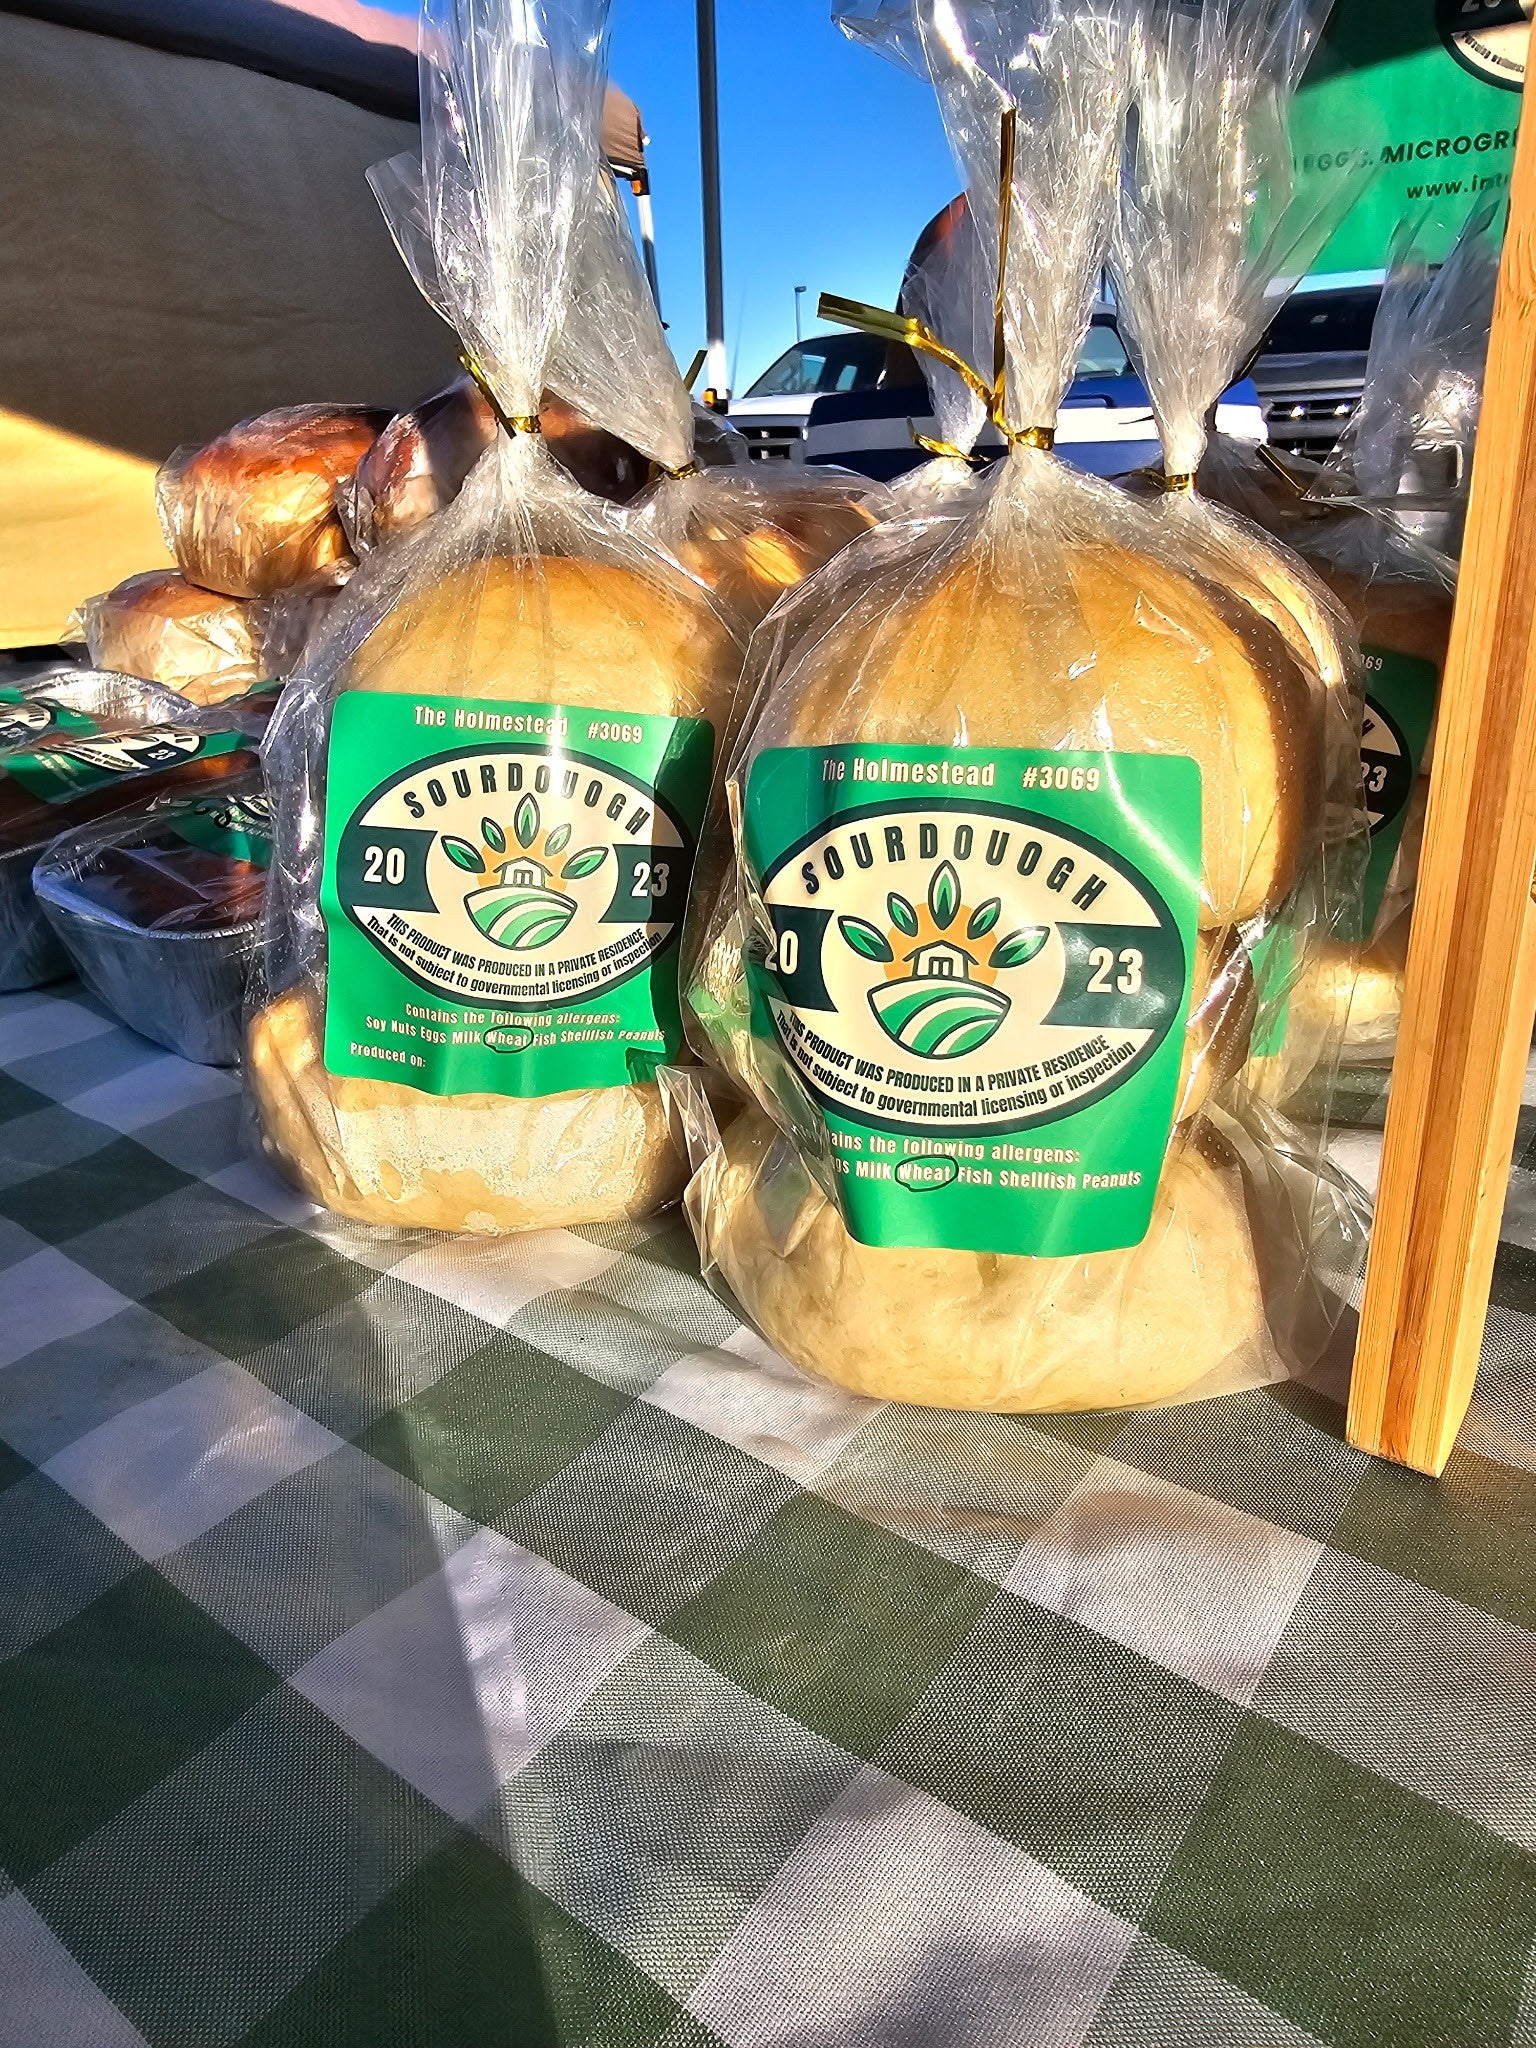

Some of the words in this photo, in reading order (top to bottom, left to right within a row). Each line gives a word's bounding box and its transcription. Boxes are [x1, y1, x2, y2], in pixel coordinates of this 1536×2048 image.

[415, 706, 446, 727] The
[454, 708, 568, 736] Holmestead
[587, 722, 643, 744] #3069
[821, 758, 846, 782] The
[853, 757, 996, 787] Holmestead
[1022, 765, 1101, 791] #3069
[403, 762, 651, 836] SOURDOUOGH
[363, 845, 406, 885] 20
[631, 865, 668, 898] 23
[801, 823, 1108, 912] SOURDOUOGH
[367, 916, 389, 935] That
[388, 932, 398, 947] is
[399, 943, 416, 962] not
[415, 955, 456, 984] subject
[456, 972, 469, 988] to
[470, 978, 549, 996] governmental
[552, 970, 600, 993] licensing
[601, 962, 612, 977] or
[613, 931, 662, 971] inspection
[386, 913, 409, 936] THIS
[409, 927, 452, 961] PRODUCT
[451, 950, 477, 970] WAS
[477, 959, 531, 977] PRODUCED
[534, 963, 545, 977] IN
[548, 962, 556, 976] A
[557, 954, 598, 975] PRIVATE
[599, 928, 645, 962] RESIDENCE
[1086, 947, 1143, 995] 23
[366, 1015, 387, 1032] Soy
[391, 1020, 417, 1037] Nuts
[420, 1026, 447, 1044] Eggs
[452, 1030, 481, 1045] Milk
[485, 1031, 528, 1047] Wheat
[532, 1033, 557, 1047] Fish
[560, 1029, 614, 1043] Shellfish
[618, 1028, 666, 1041] Peanuts
[405, 1003, 458, 1024] Contains
[463, 1011, 485, 1024] the
[490, 1012, 552, 1027] following
[556, 1012, 620, 1025] allergens:
[349, 1042, 406, 1064] Produced
[410, 1054, 426, 1068] on:
[776, 1009, 792, 1041] That
[790, 1031, 798, 1051] is
[796, 1045, 814, 1070] not
[812, 1062, 859, 1099] subject
[860, 1086, 875, 1105] to
[877, 1093, 977, 1118] governmental
[981, 1087, 1047, 1115] licensing
[1049, 1080, 1065, 1098] or
[1064, 1041, 1136, 1091] inspection
[789, 1010, 806, 1038] THIS
[804, 1030, 854, 1070] PRODUCT
[854, 1058, 884, 1083] WAS
[886, 1068, 954, 1093] PRODUCED
[958, 1076, 971, 1093] IN
[975, 1075, 985, 1092] A
[987, 1064, 1042, 1091] PRIVATE
[1041, 1034, 1110, 1077] RESIDENCE
[831, 1131, 863, 1150] ains
[869, 1135, 897, 1154] the
[903, 1138, 985, 1159] following
[991, 1143, 1081, 1164] allergens:
[855, 1160, 892, 1180] Milk
[898, 1162, 951, 1182] Wheat
[957, 1166, 993, 1185] Fish
[1000, 1170, 1077, 1190] Shellfish
[1082, 1171, 1142, 1189] Peanuts
